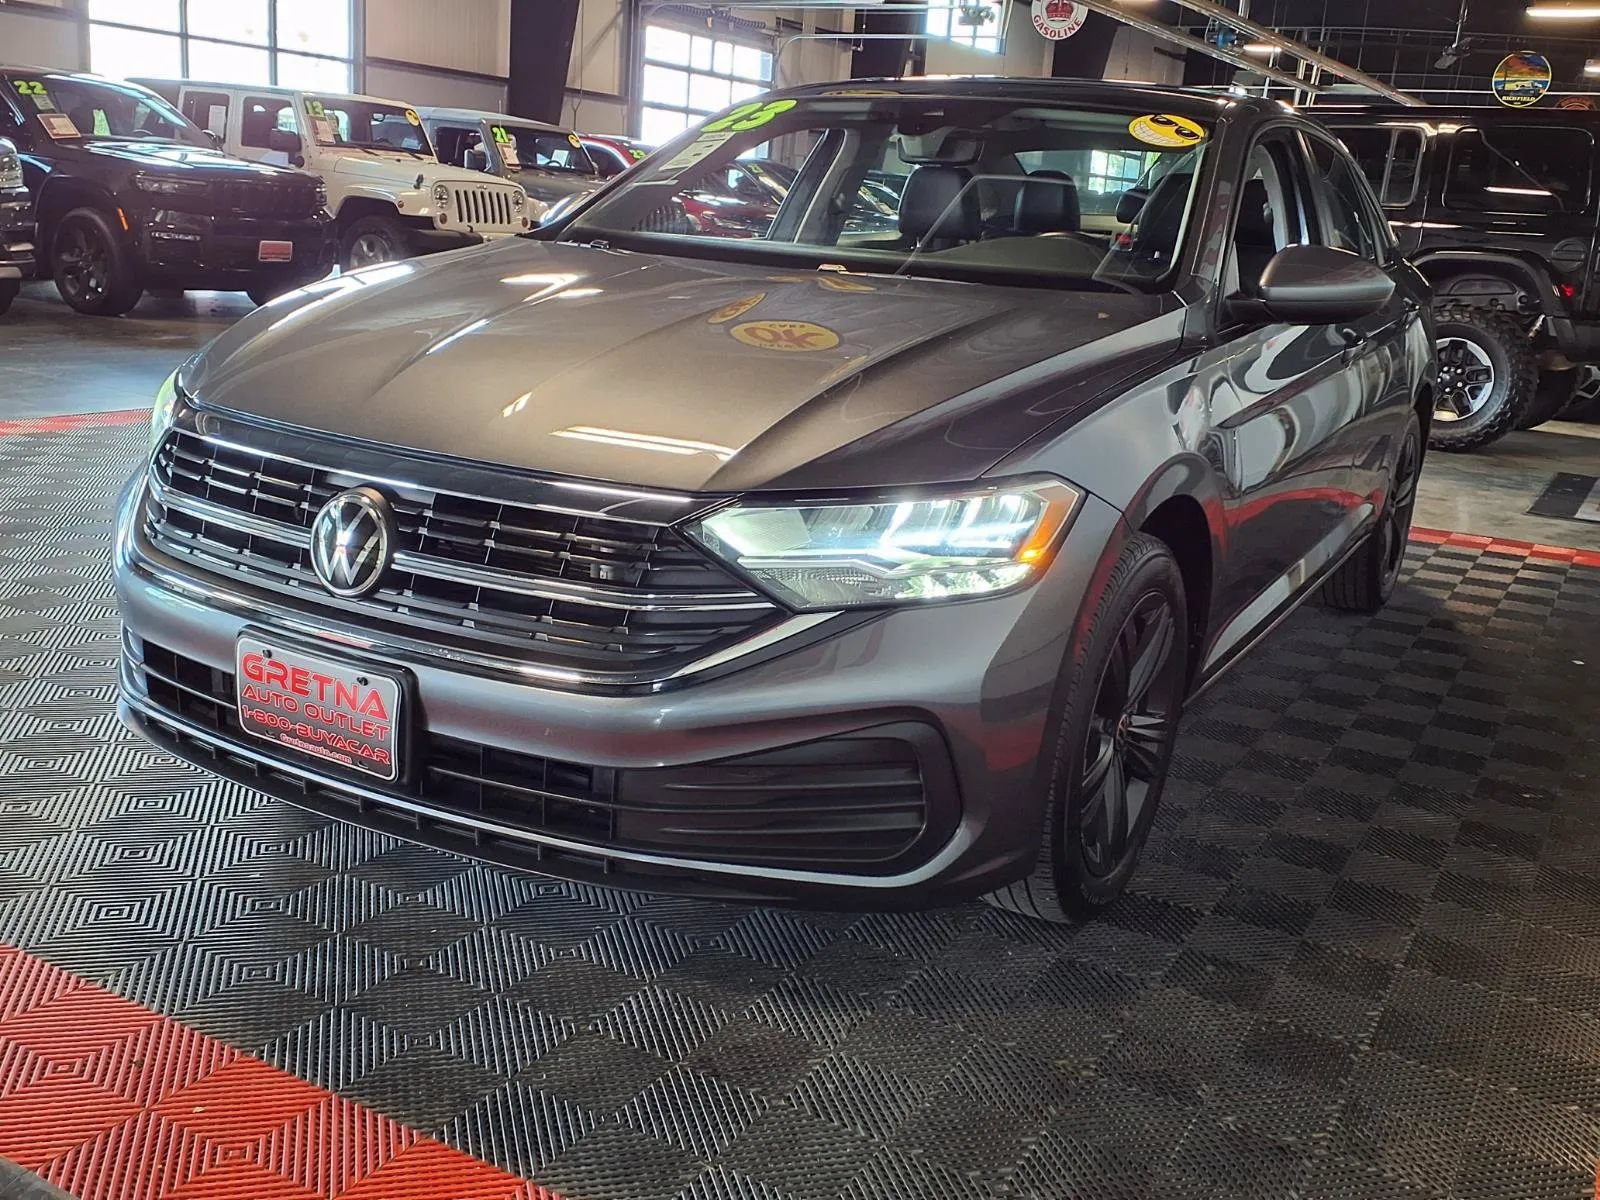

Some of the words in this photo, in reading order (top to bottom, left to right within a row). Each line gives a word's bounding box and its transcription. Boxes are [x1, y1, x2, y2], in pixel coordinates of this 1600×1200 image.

[1033, 14, 1082, 39] GASOLINE
[13, 80, 49, 95] 22
[700, 98, 798, 132] 23
[241, 652, 389, 721] GRETNA
[242, 683, 298, 713] AUTO
[303, 703, 391, 742] OUTLET
[242, 704, 391, 765] 1-800-BUYACAR
